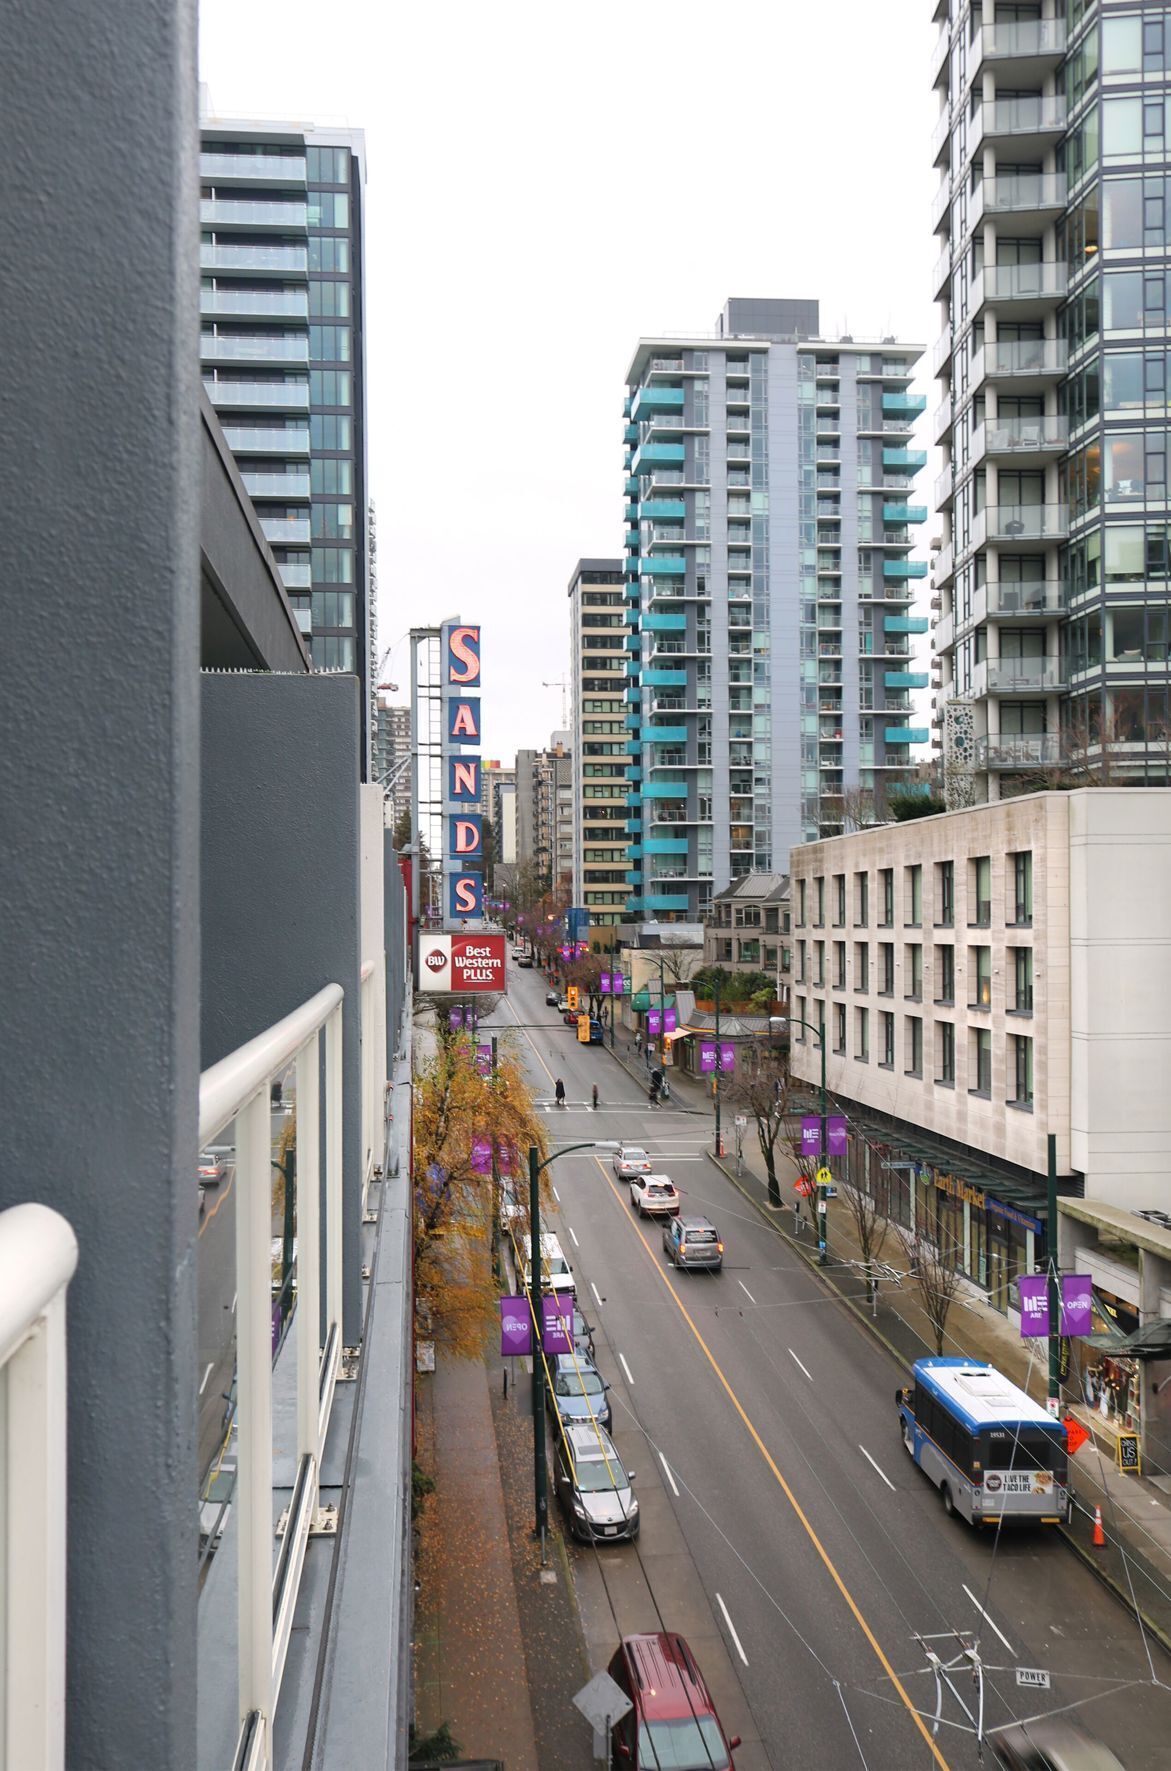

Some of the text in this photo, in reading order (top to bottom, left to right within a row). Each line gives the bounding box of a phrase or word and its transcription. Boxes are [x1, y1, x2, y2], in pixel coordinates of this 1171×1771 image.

[449, 627, 480, 912] SANDS
[465, 945, 492, 957] Best
[427, 955, 446, 966] BW
[454, 956, 502, 968] Western
[933, 1167, 986, 1210] Earth Market
[1023, 1295, 1048, 1312] WE
[1066, 1301, 1088, 1309] OPEN
[1122, 1447, 1136, 1459] US
[1018, 1474, 1029, 1483] THE
[1019, 1483, 1031, 1492] LIFE
[1020, 1671, 1046, 1682] POWER
